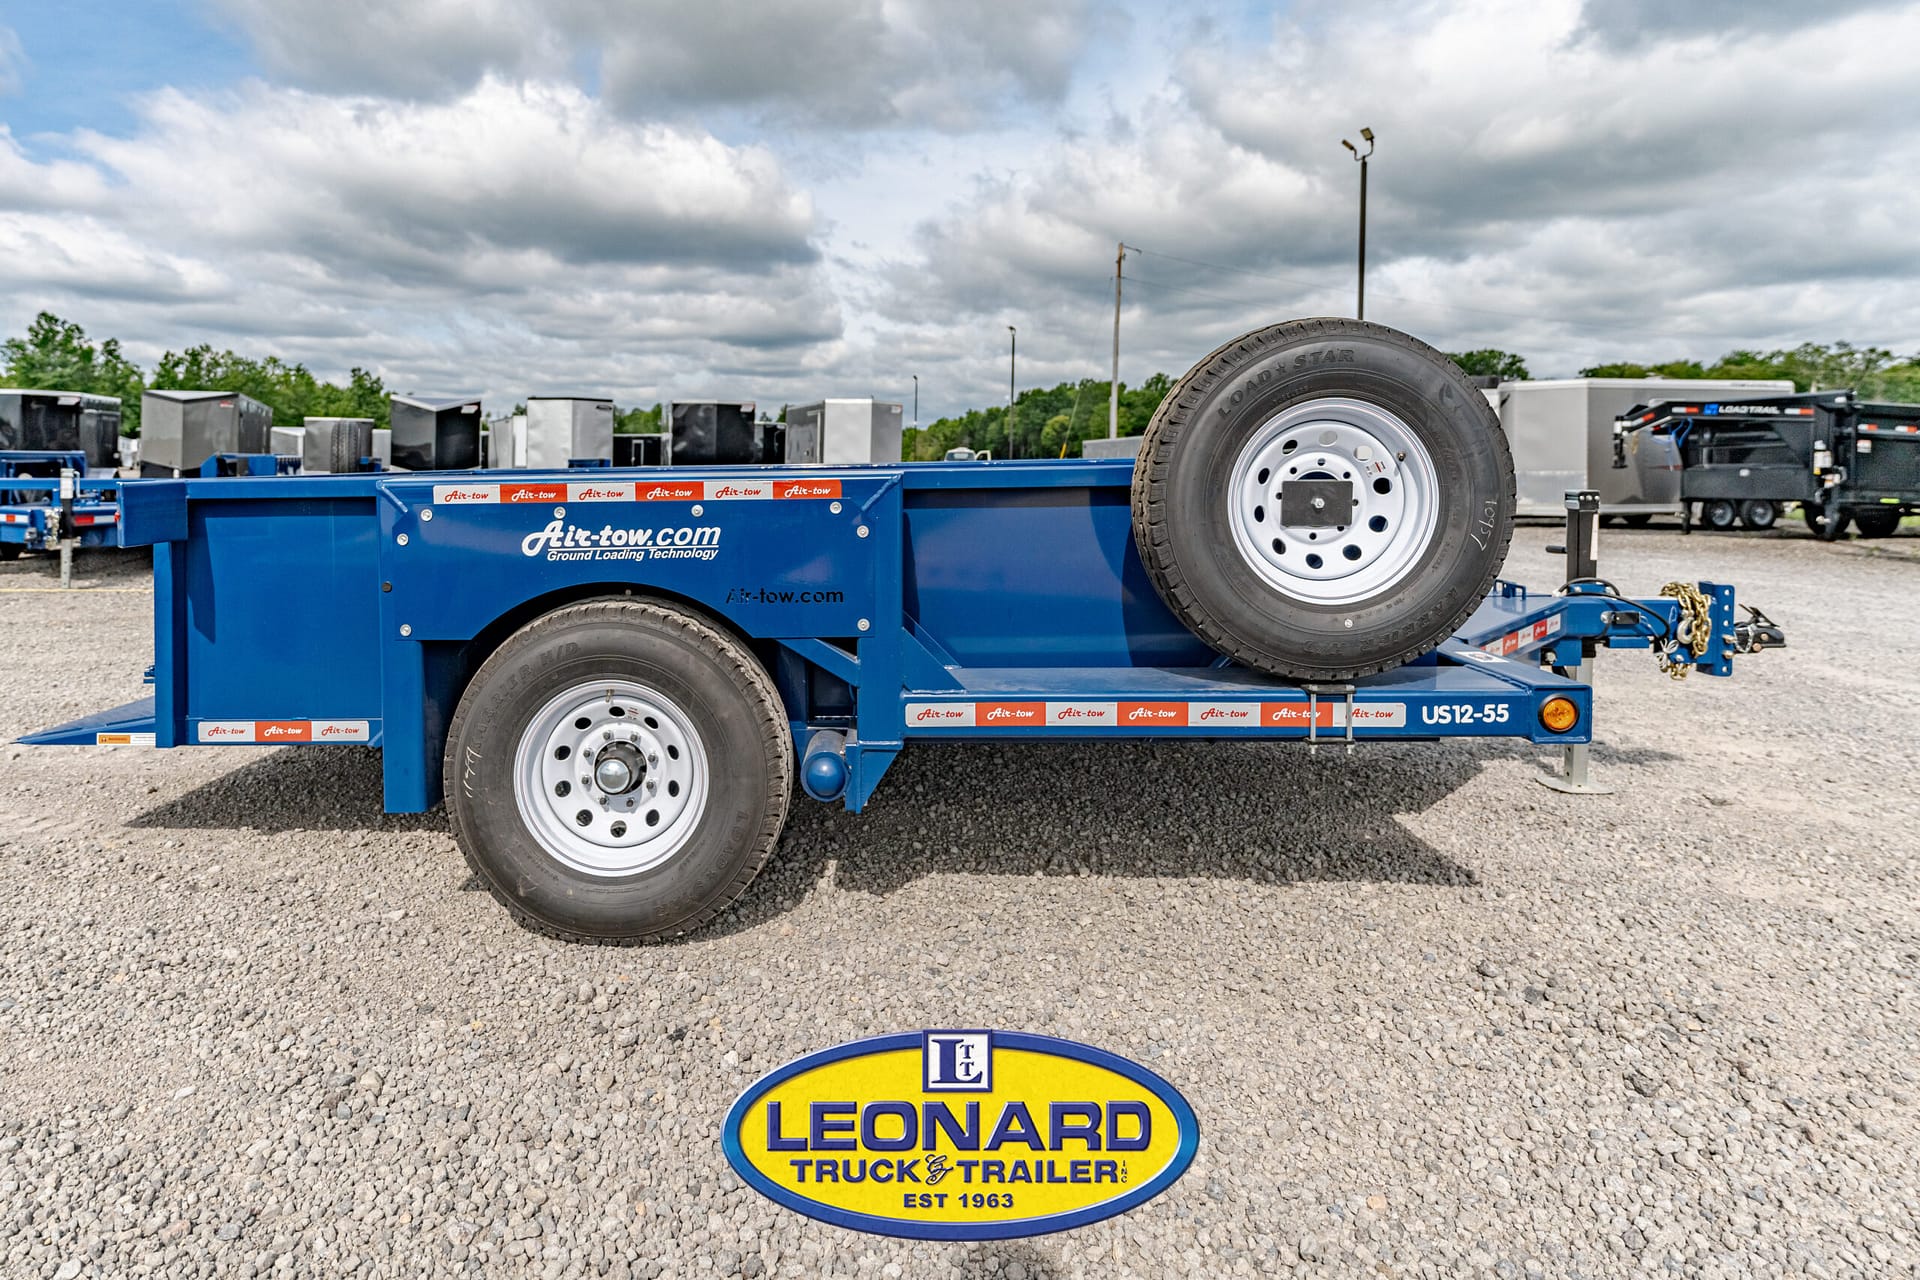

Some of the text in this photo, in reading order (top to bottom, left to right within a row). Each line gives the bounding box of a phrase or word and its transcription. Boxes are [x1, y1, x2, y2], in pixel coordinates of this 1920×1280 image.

[1218, 369, 1272, 419] LOAD
[1293, 349, 1354, 370] STAR
[444, 485, 831, 502] Air-tow Air-tow Air-tow Air-tow Air-tow Air-tow
[521, 519, 721, 557] Air-tow.com
[547, 548, 719, 562] Ground Loading Technology
[726, 587, 844, 604] Air-tow.com
[917, 707, 964, 721] Air-tow
[986, 707, 1035, 720] Air-tow
[1057, 707, 1105, 720] Air-tow
[1128, 707, 1177, 720] Air-tow
[1200, 707, 1248, 721] Air-tow
[1421, 703, 1509, 725] US12-55
[207, 726, 360, 738] Air-tow Air-tow Air-tow
